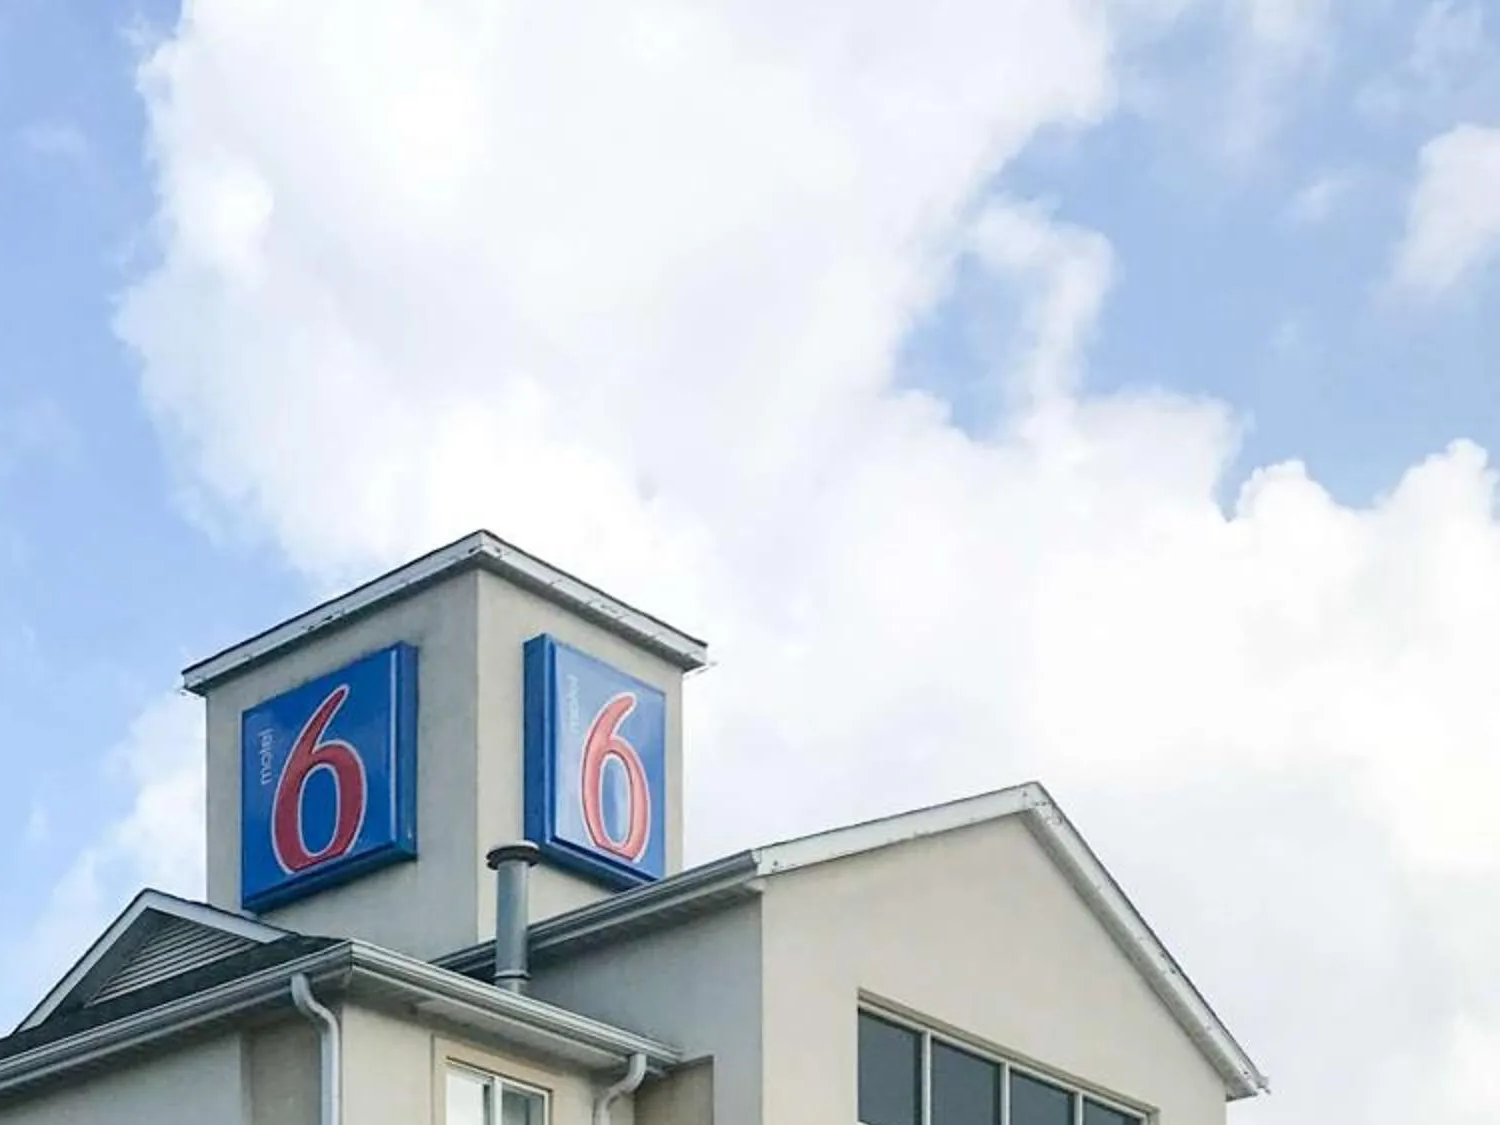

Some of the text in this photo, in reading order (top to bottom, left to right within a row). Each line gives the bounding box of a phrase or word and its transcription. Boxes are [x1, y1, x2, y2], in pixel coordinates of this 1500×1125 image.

[257, 728, 274, 785] motel
[271, 684, 367, 875] 6
[581, 692, 651, 864] 6
